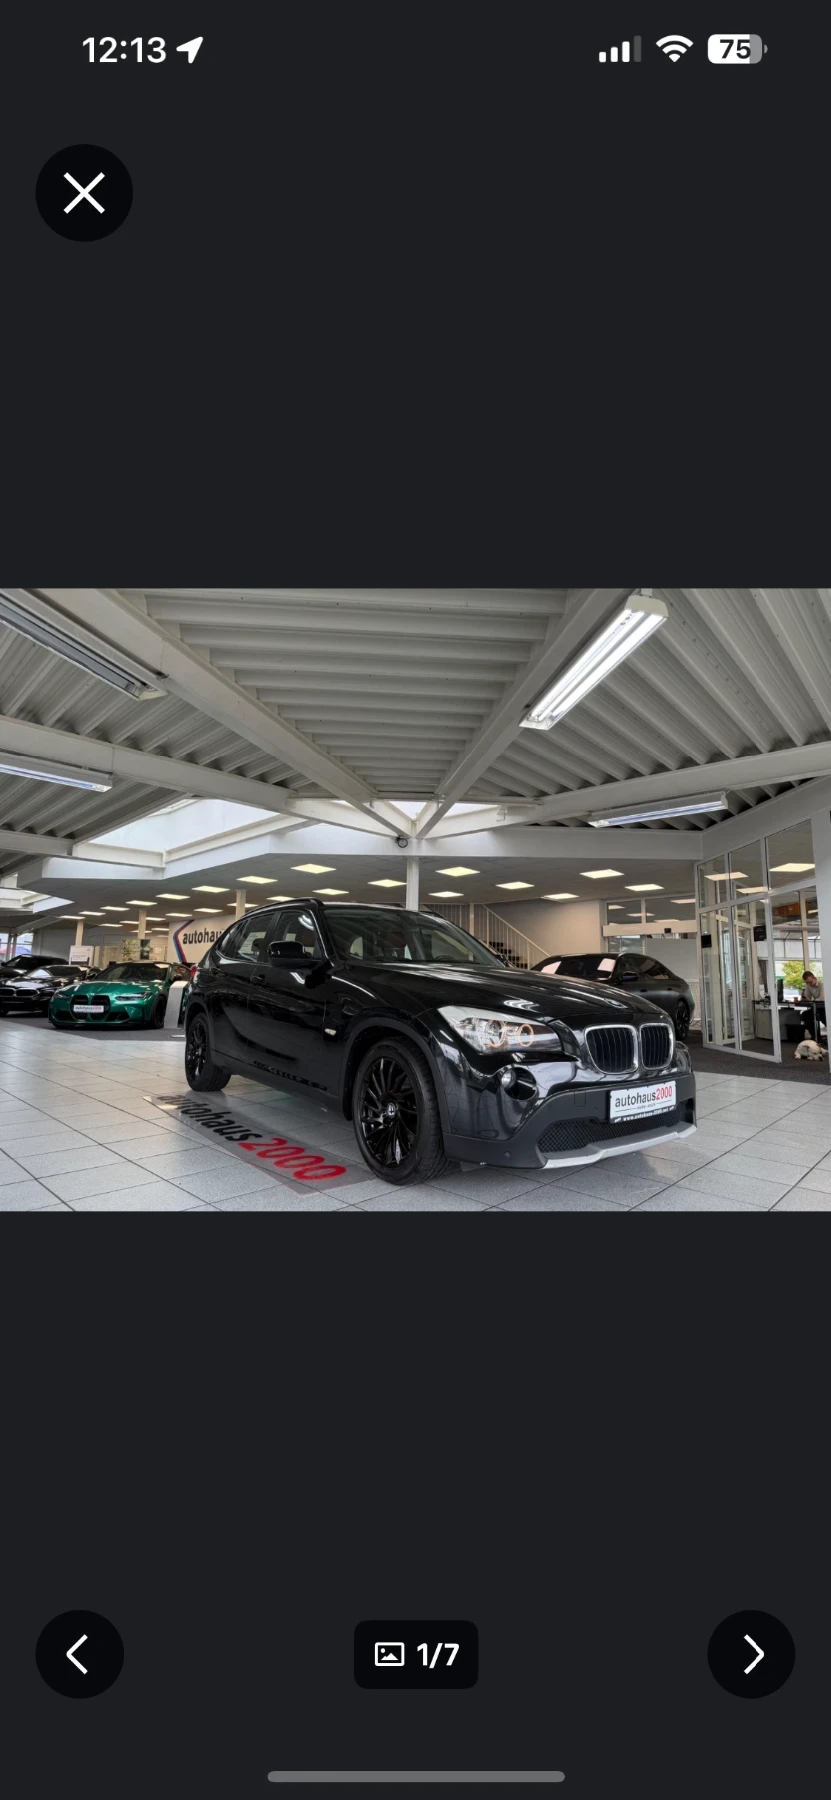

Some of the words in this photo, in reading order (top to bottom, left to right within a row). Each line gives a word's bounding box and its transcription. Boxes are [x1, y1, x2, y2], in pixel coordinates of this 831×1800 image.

[183, 927, 225, 944] autohau
[615, 1086, 672, 1107] autohaus2000
[156, 1094, 347, 1181] autohaus2000
